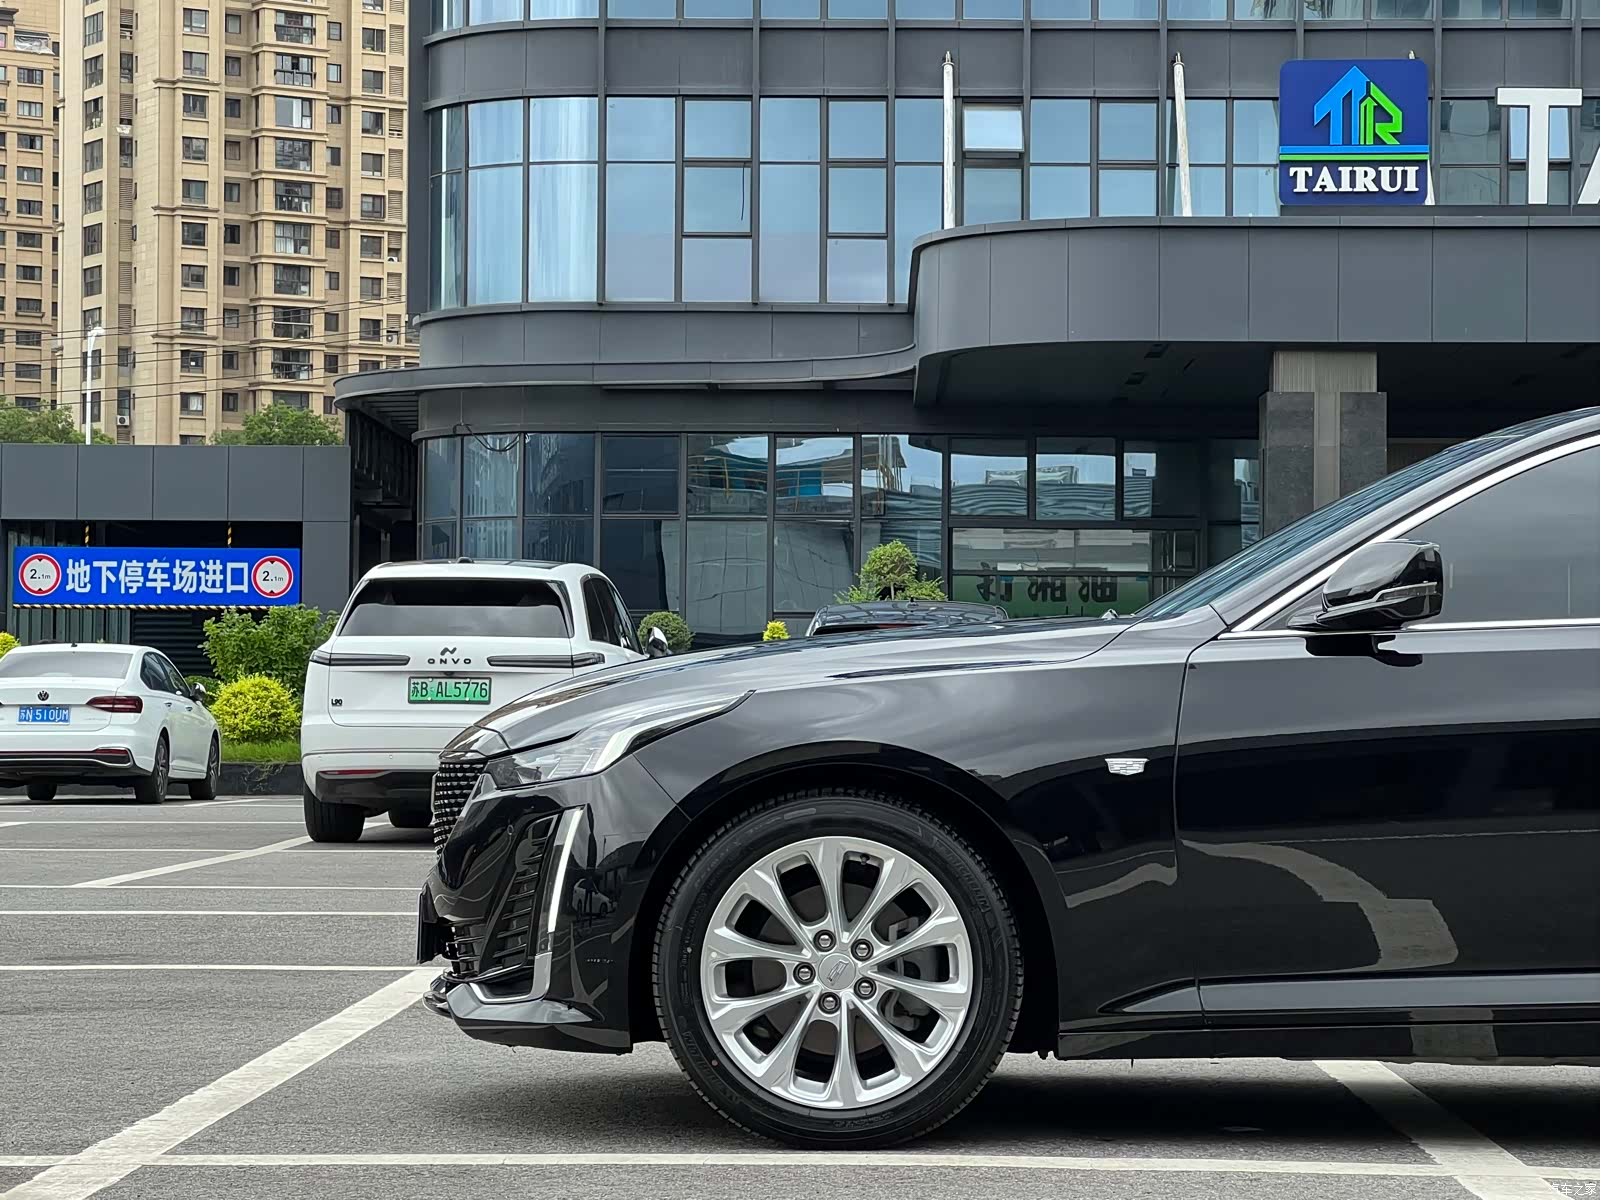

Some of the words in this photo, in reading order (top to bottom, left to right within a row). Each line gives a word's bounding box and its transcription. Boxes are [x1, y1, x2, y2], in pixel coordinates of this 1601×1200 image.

[1289, 166, 1420, 194] TAIRUI
[65, 558, 249, 594] 地下停车场进口
